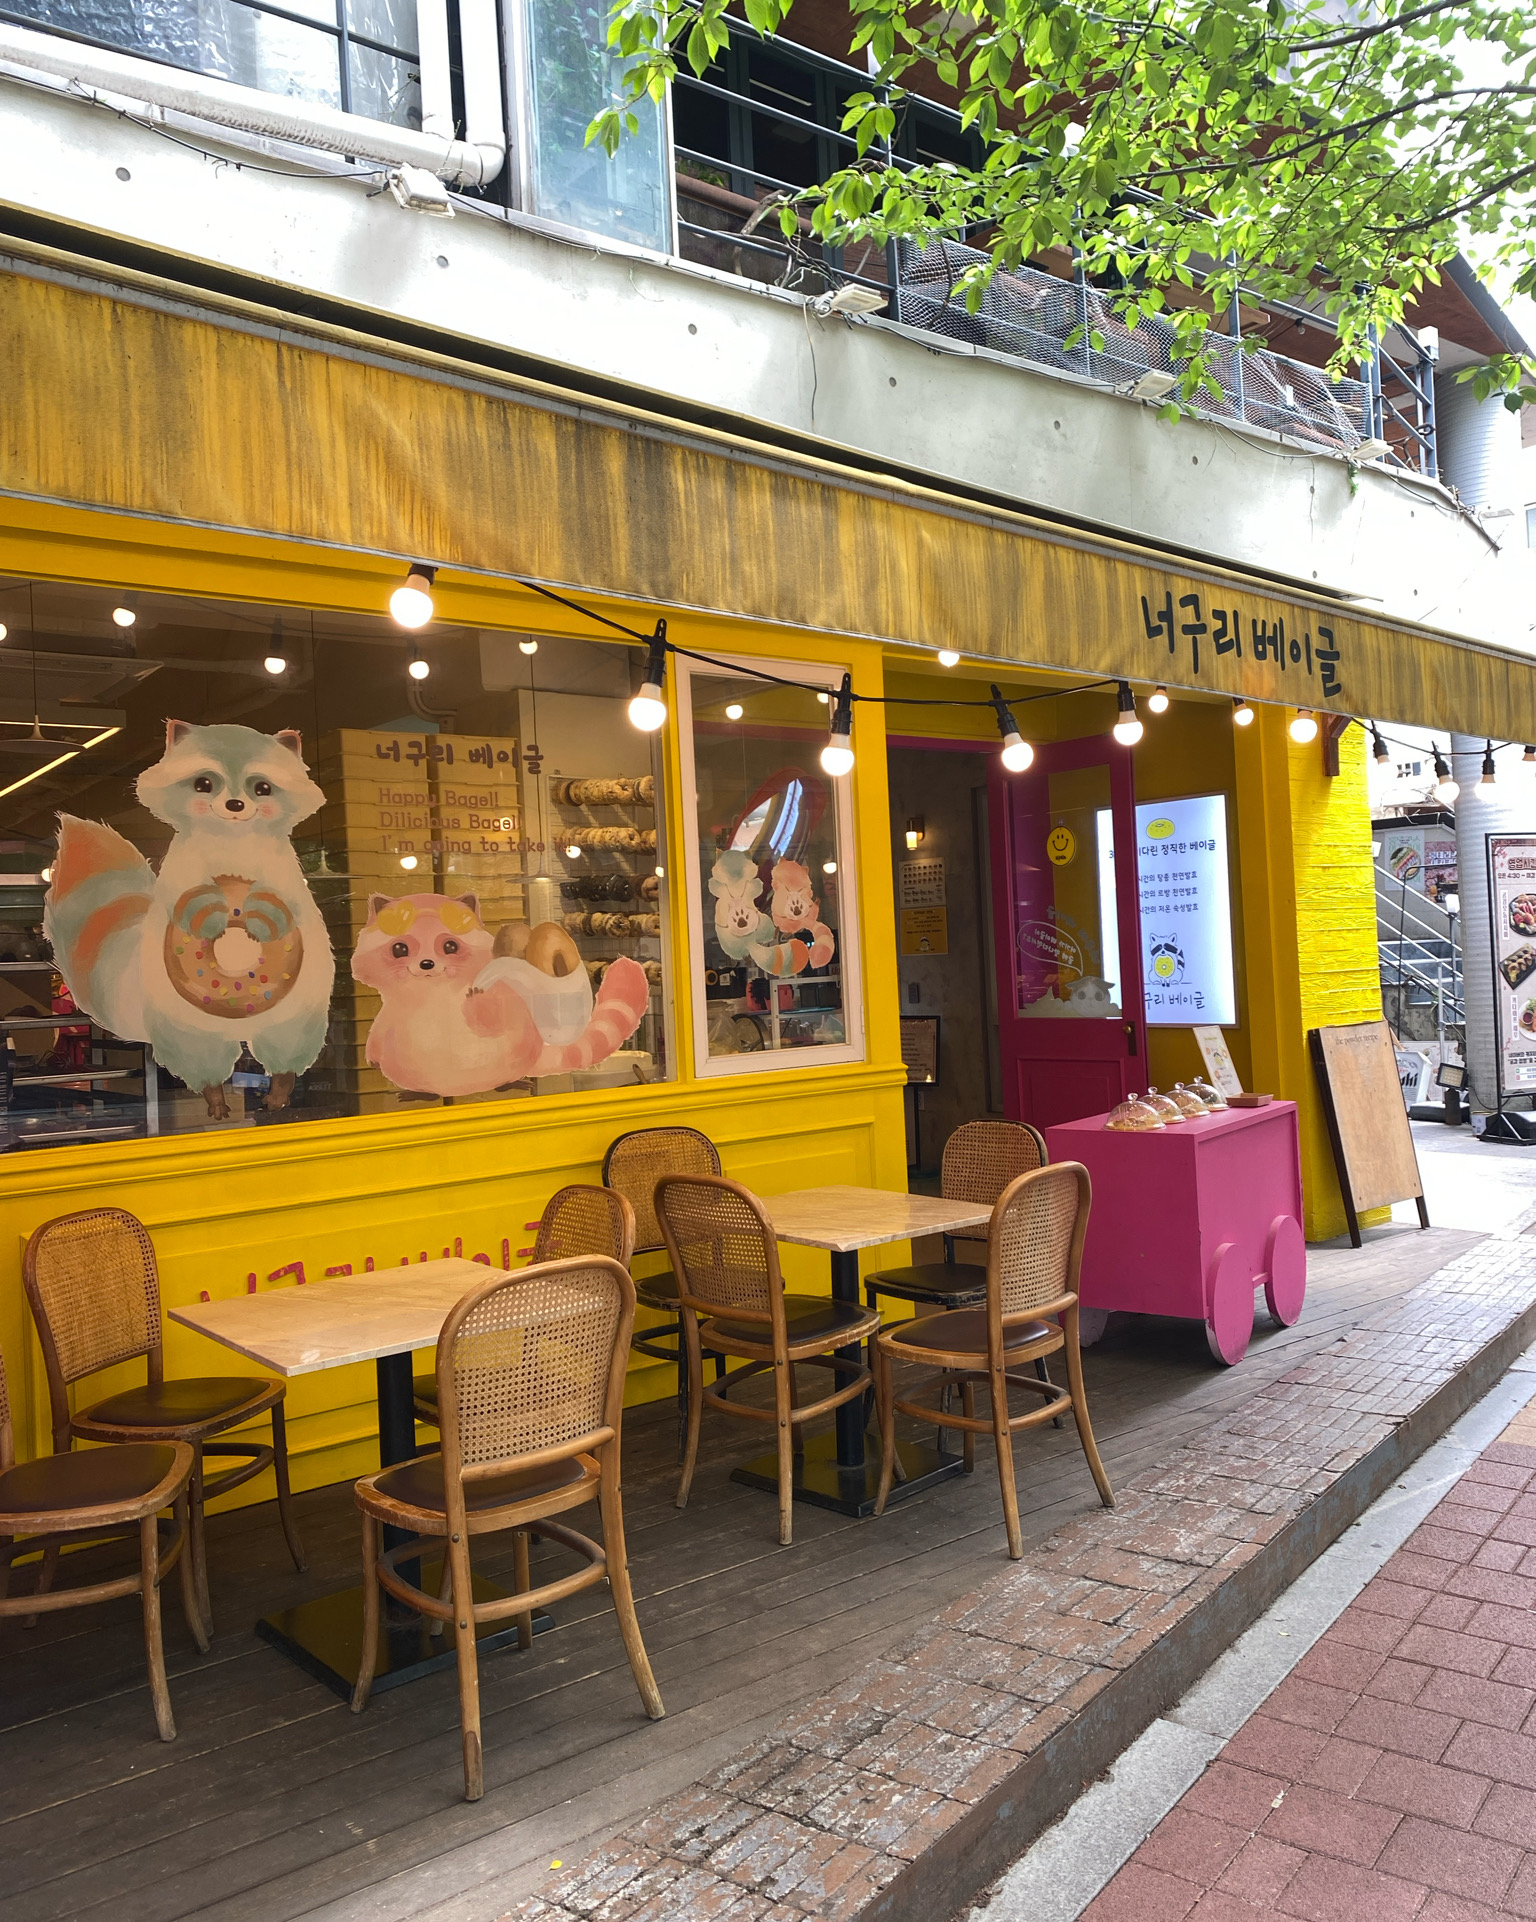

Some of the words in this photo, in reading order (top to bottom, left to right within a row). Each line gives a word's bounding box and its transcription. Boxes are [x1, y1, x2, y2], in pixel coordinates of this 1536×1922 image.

[1141, 591, 1242, 674] 너구리
[1252, 616, 1342, 698] 베이글
[376, 740, 454, 767] 너구리
[468, 743, 544, 775] 베이글
[379, 788, 437, 808] Happy
[445, 790, 499, 808] Bagel!
[380, 812, 461, 829] Dilicious
[469, 813, 522, 831] Bagel!
[424, 838, 472, 855] going
[480, 836, 499, 852] to
[507, 836, 545, 853] take
[1161, 842, 1187, 856] 정직한
[1189, 839, 1216, 851] 베이글
[1144, 991, 1165, 1009] 구리
[1168, 991, 1205, 1010] 베이글
